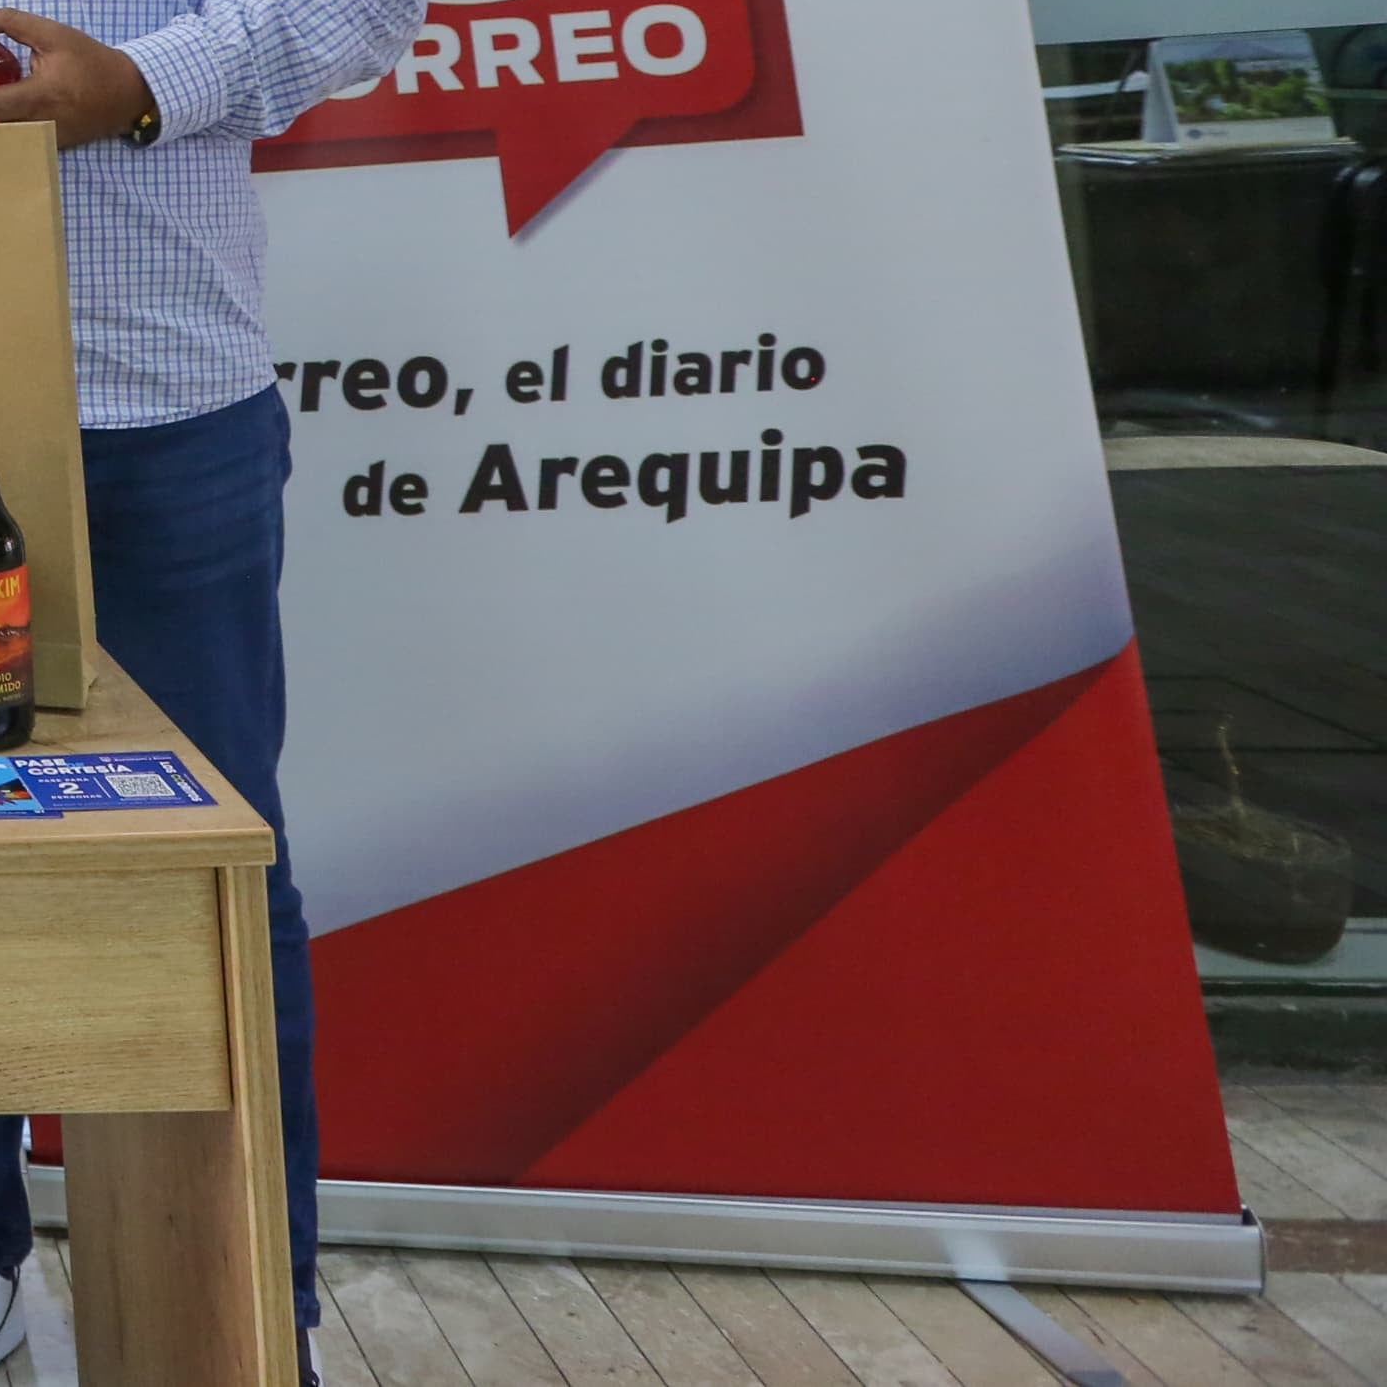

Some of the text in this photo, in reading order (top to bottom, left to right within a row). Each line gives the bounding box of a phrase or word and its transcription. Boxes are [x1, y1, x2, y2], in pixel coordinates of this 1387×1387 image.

[325, 4, 708, 101] RREO
[504, 345, 570, 404] el
[600, 333, 826, 400] diario
[343, 428, 907, 526] de Arequipa
[14, 758, 65, 769] PASE
[28, 763, 133, 776] CORTESÍA
[58, 782, 84, 795] 2
